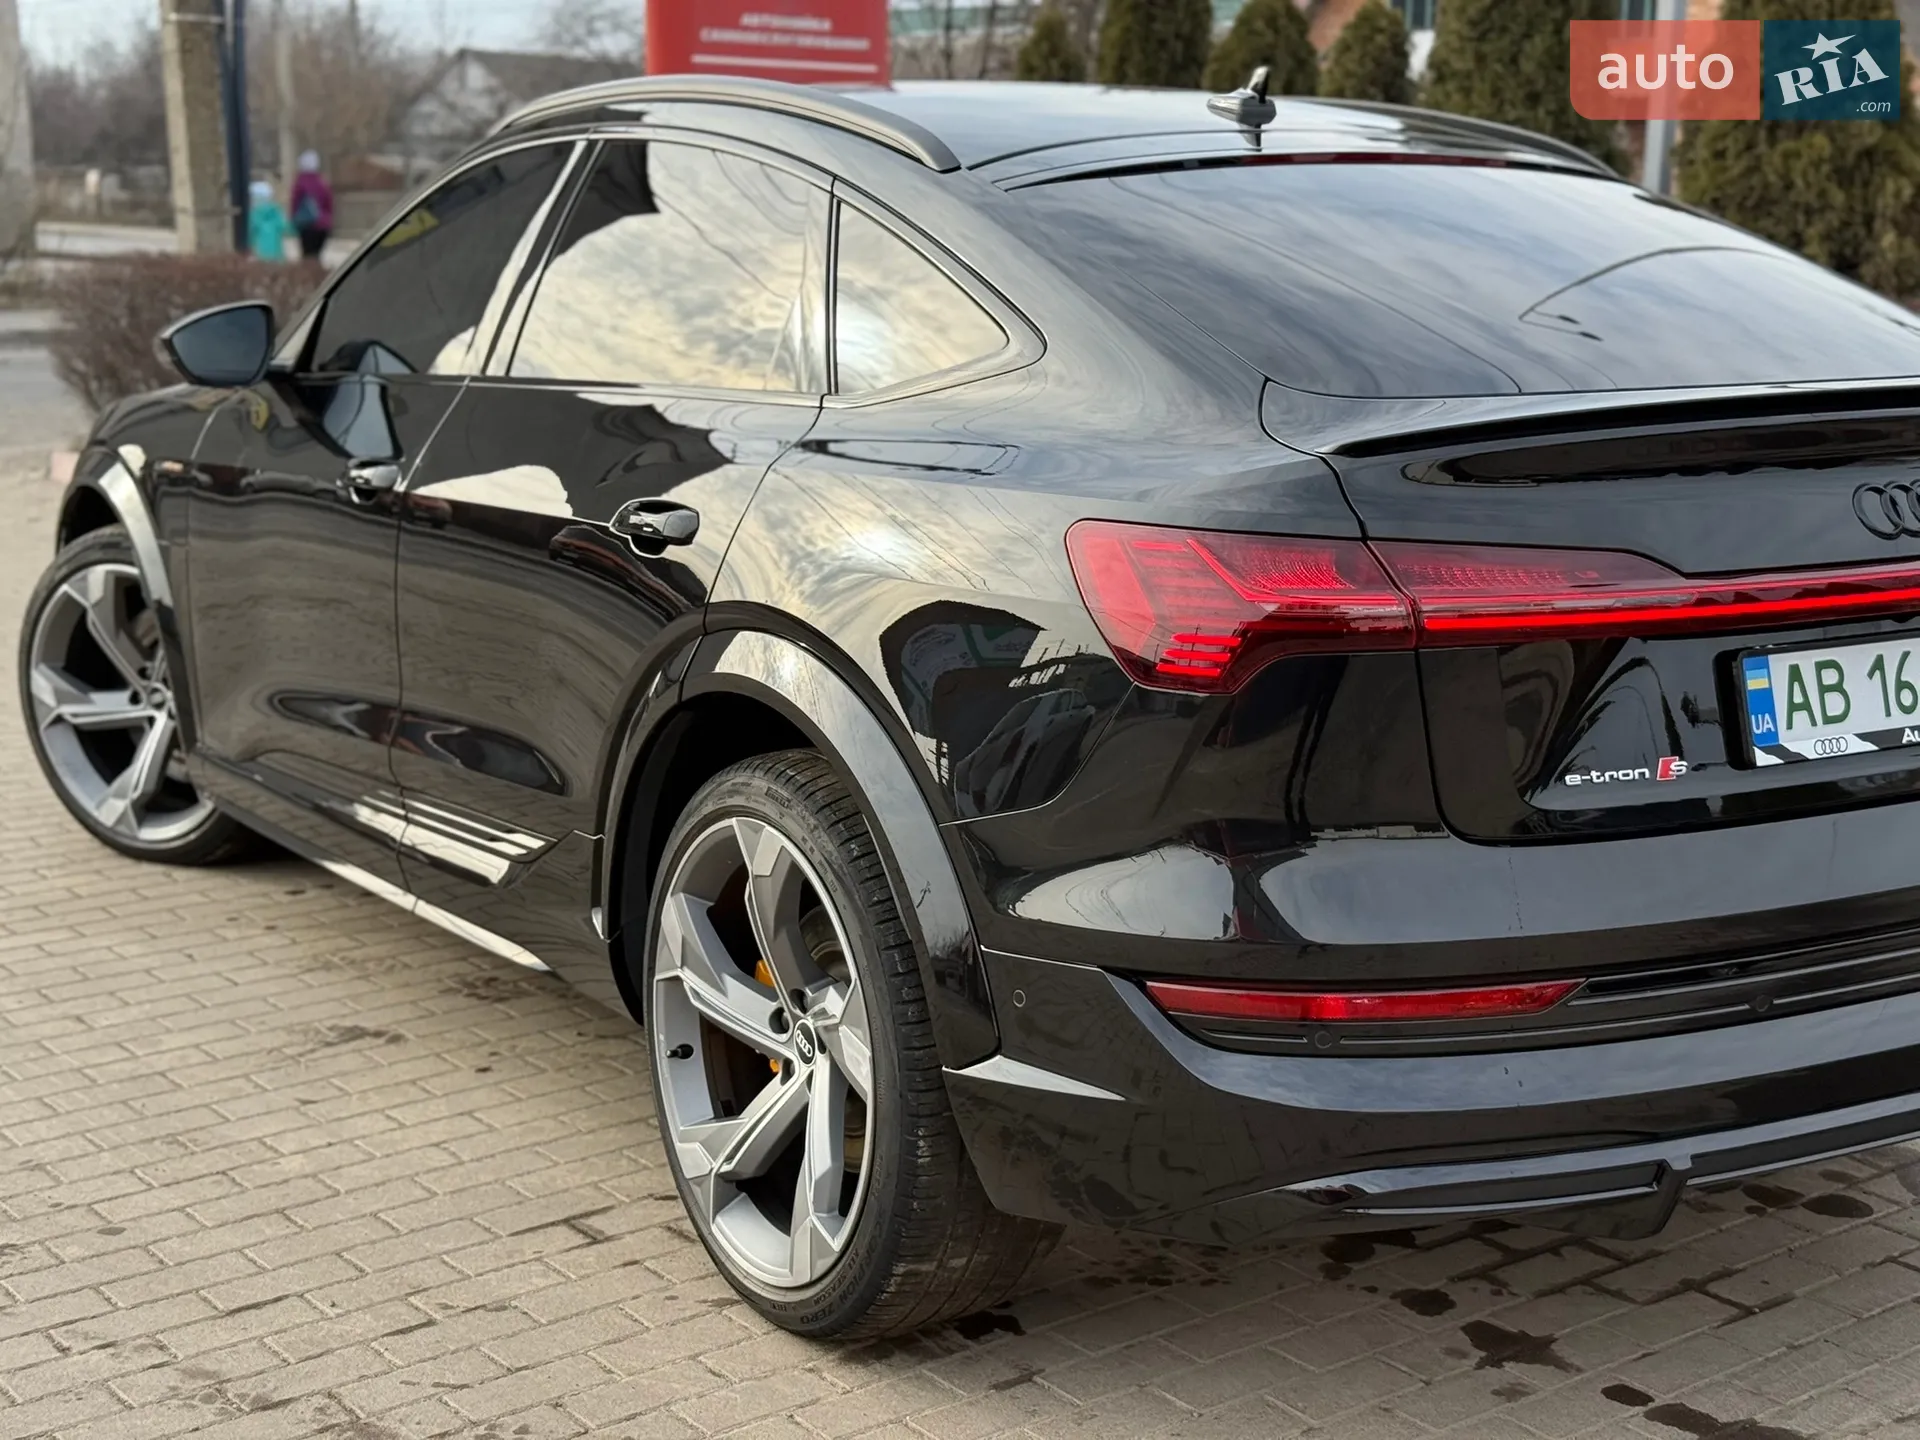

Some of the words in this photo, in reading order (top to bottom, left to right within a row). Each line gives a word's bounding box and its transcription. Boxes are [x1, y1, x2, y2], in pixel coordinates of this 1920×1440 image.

[1786, 659, 1851, 730] AB
[1866, 650, 1919, 718] 16
[1751, 713, 1775, 734] UA
[1565, 768, 1650, 787] e-tron
[800, 1303, 836, 1325] ZERO
